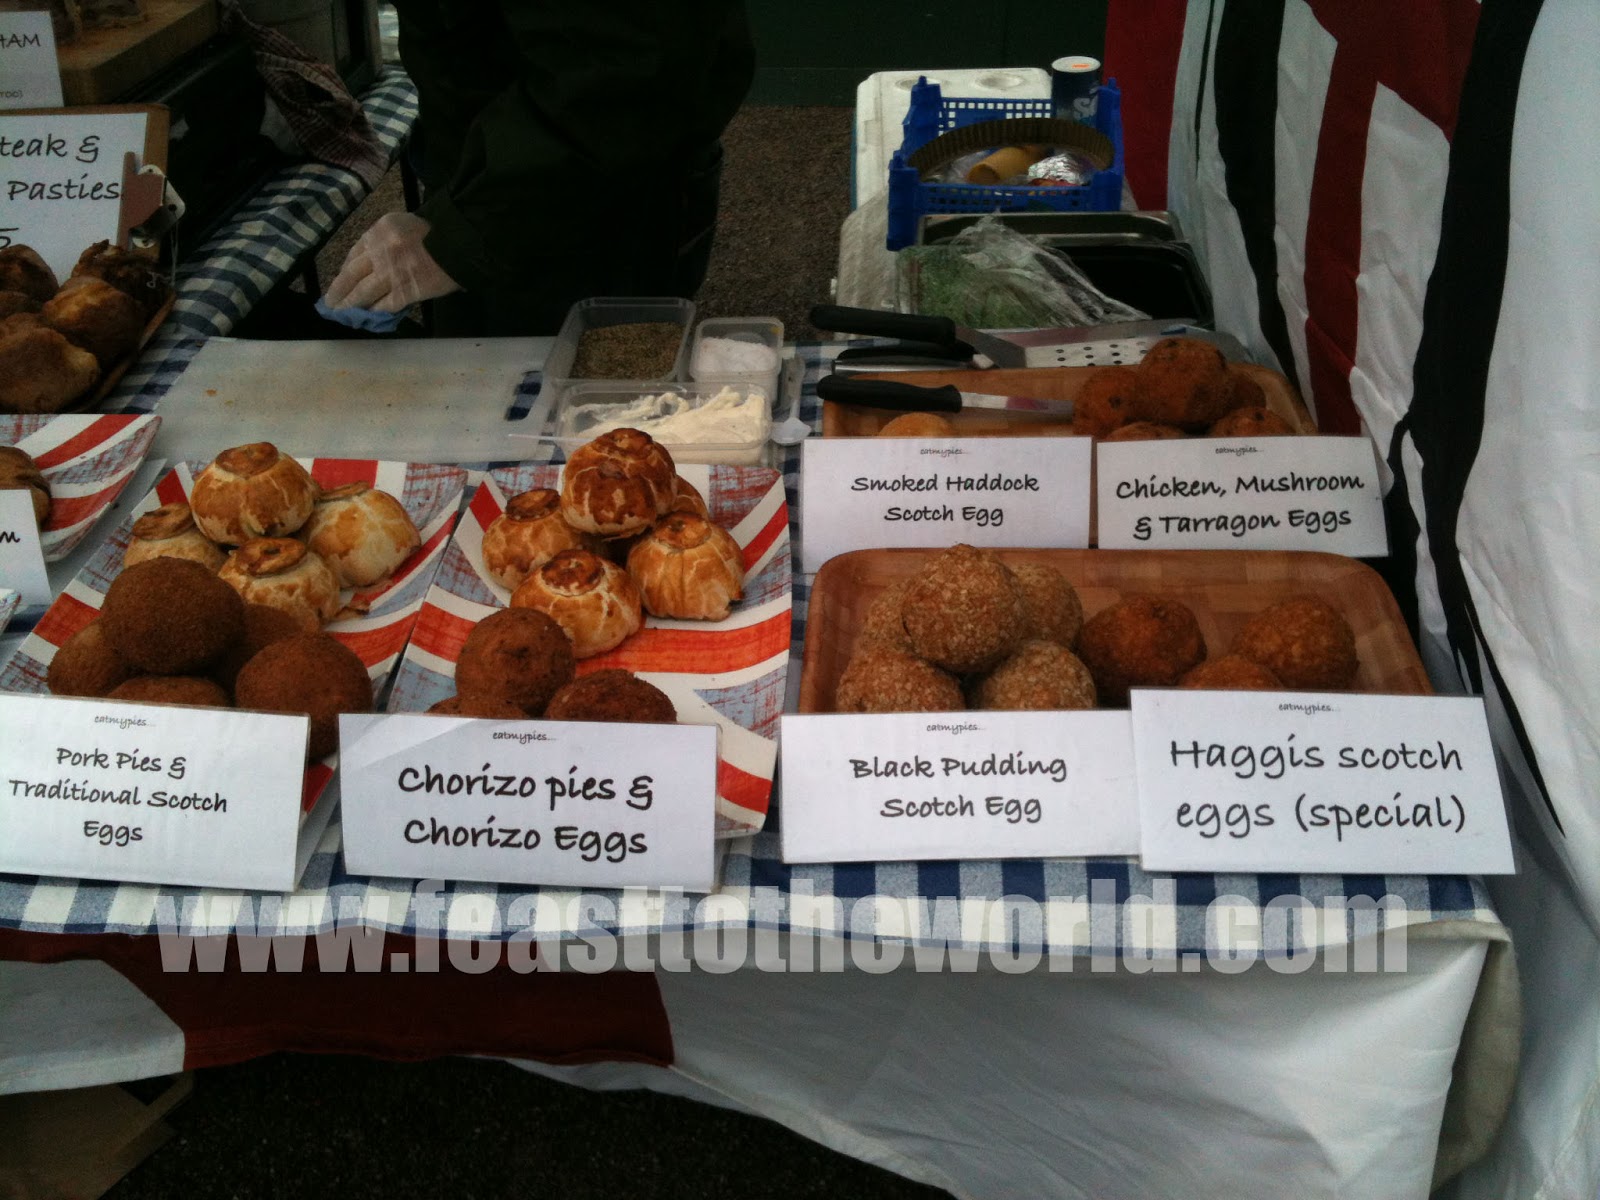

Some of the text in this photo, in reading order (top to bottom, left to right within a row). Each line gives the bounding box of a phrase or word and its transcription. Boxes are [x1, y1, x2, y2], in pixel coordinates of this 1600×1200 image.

[76, 135, 100, 163] &
[8, 173, 120, 200] Pasties
[851, 473, 1040, 492] Smoked Haddock
[1116, 472, 1365, 499] Chicken, Mushroom
[883, 505, 1004, 527] Scotch Egg
[1133, 509, 1352, 540] & Tarragon Eggs
[56, 748, 187, 779] Pork Pies &
[849, 751, 1068, 782] Black Pudding
[1170, 733, 1463, 779] Haggis scotch
[9, 778, 228, 813] Traditional Scotch
[398, 762, 654, 811] Chorizo pies &
[879, 794, 1042, 824] Scotch Egg
[1176, 792, 1466, 843] eggs (special)
[83, 820, 143, 847] Eggs
[403, 815, 649, 864] Chorizo Eggs
